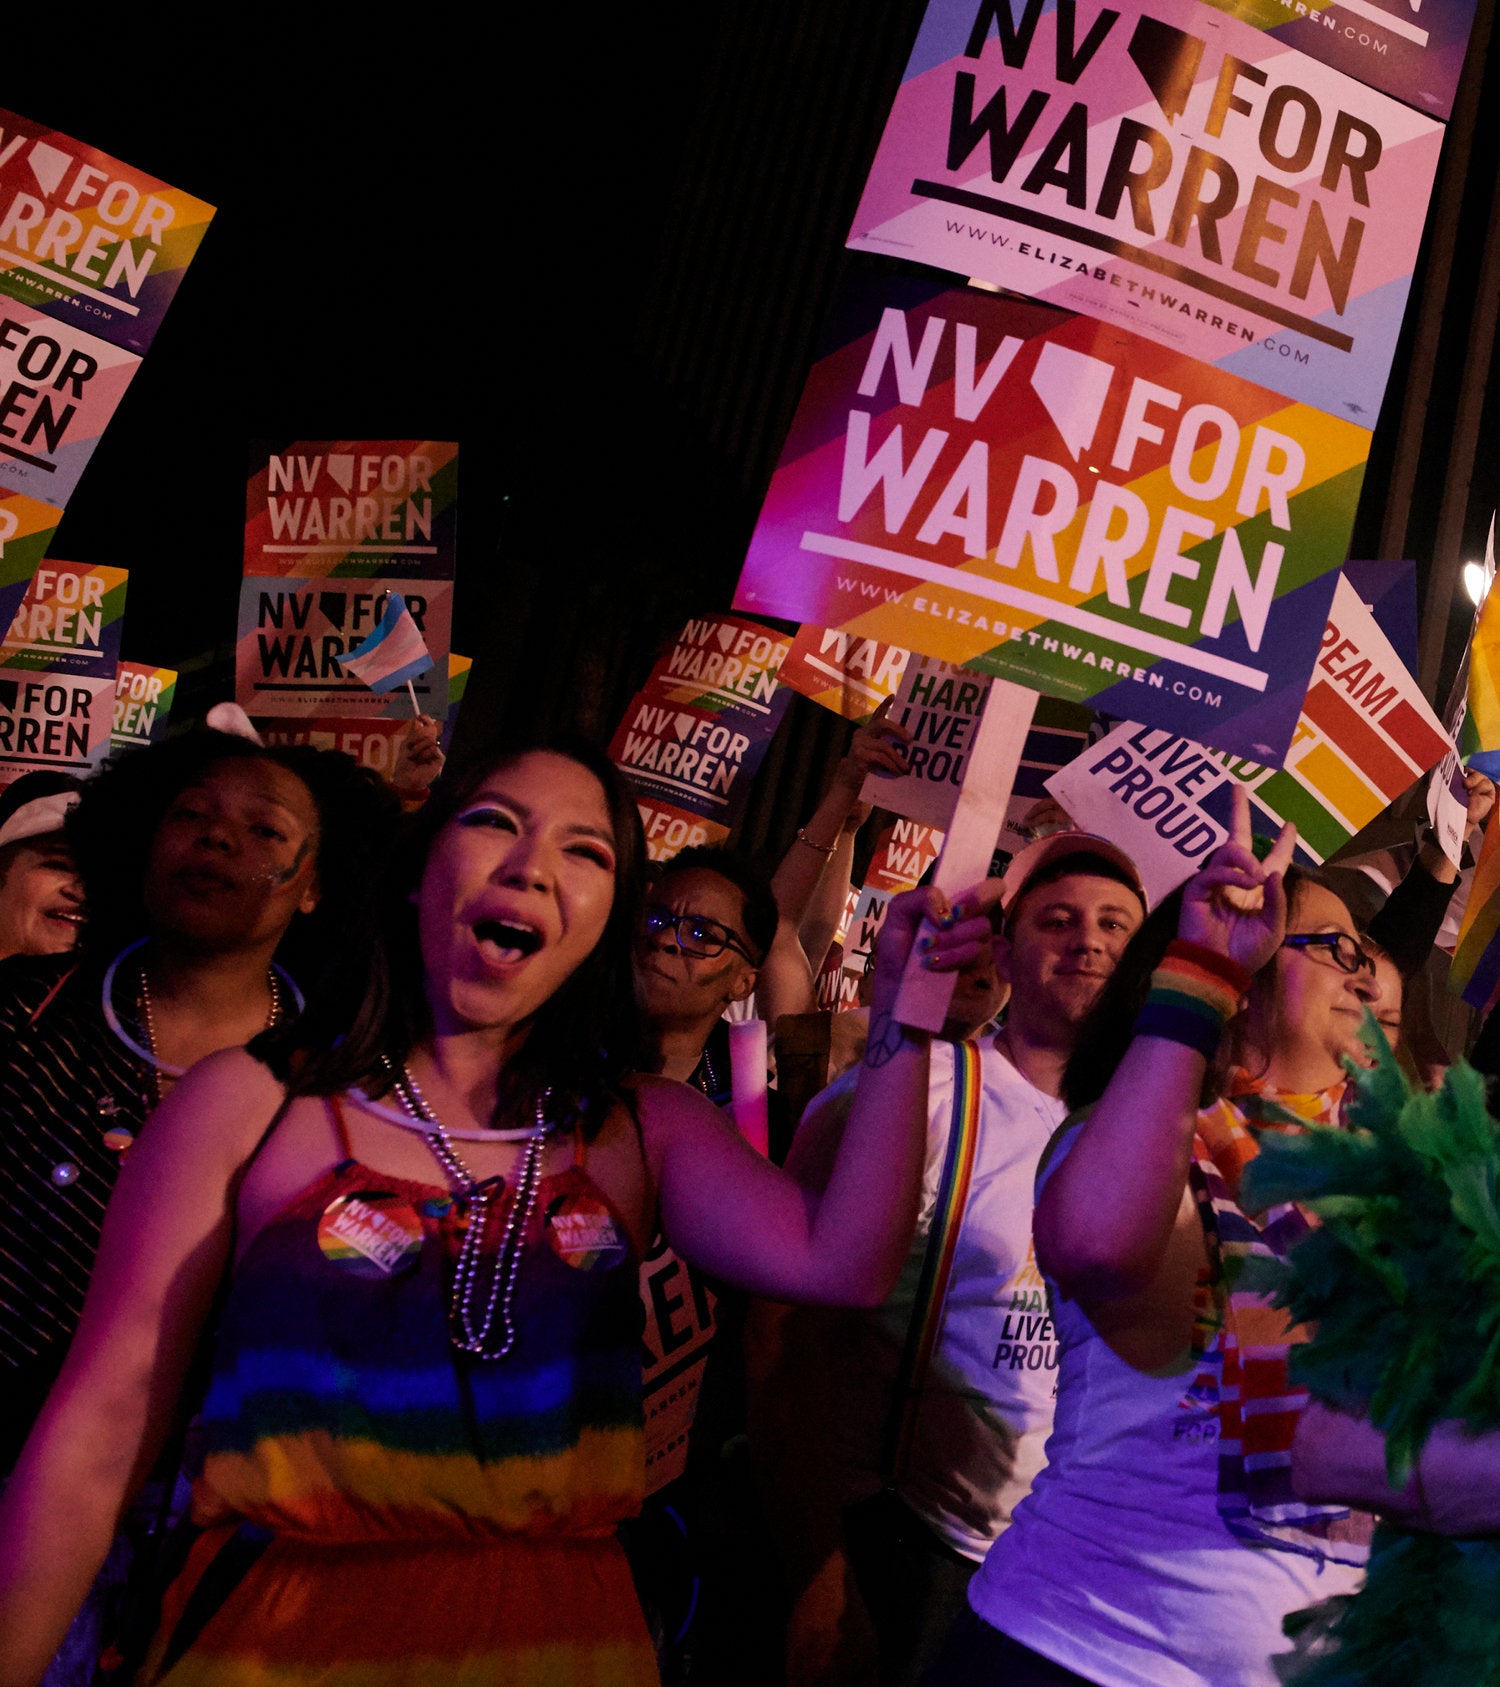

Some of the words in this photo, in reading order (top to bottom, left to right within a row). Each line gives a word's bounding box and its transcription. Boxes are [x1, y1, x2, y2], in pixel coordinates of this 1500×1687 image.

[966, 0, 1120, 85] NV
[1204, 53, 1384, 208] FOR
[65, 164, 175, 246] FOR
[945, 71, 1366, 317] WARREN
[0, 191, 157, 299] RREN
[946, 219, 1311, 366] WWW.ELIZABETHWARREN.COM
[0, 318, 98, 400] FOR
[857, 307, 1026, 423] NV
[1111, 376, 1308, 531] FOR
[267, 454, 323, 493] NV
[359, 455, 433, 493] FOR
[266, 496, 433, 542] WARREN
[837, 409, 1286, 653] WARREN
[35, 568, 105, 608] FOR
[257, 592, 314, 630] NV
[679, 619, 718, 647] NV
[836, 576, 1224, 711] WWW.ELIZABETHWARREN.COM
[22, 683, 93, 719] FOR
[115, 670, 163, 704] FOR
[667, 644, 779, 705] WARREN
[908, 672, 988, 717] HAR
[620, 730, 739, 796] WARREN
[632, 704, 676, 736] NV
[690, 719, 751, 764] FOR
[891, 818, 929, 847] NV
[1089, 746, 1217, 860] PROUD
[1008, 1290, 1050, 1313] HA
